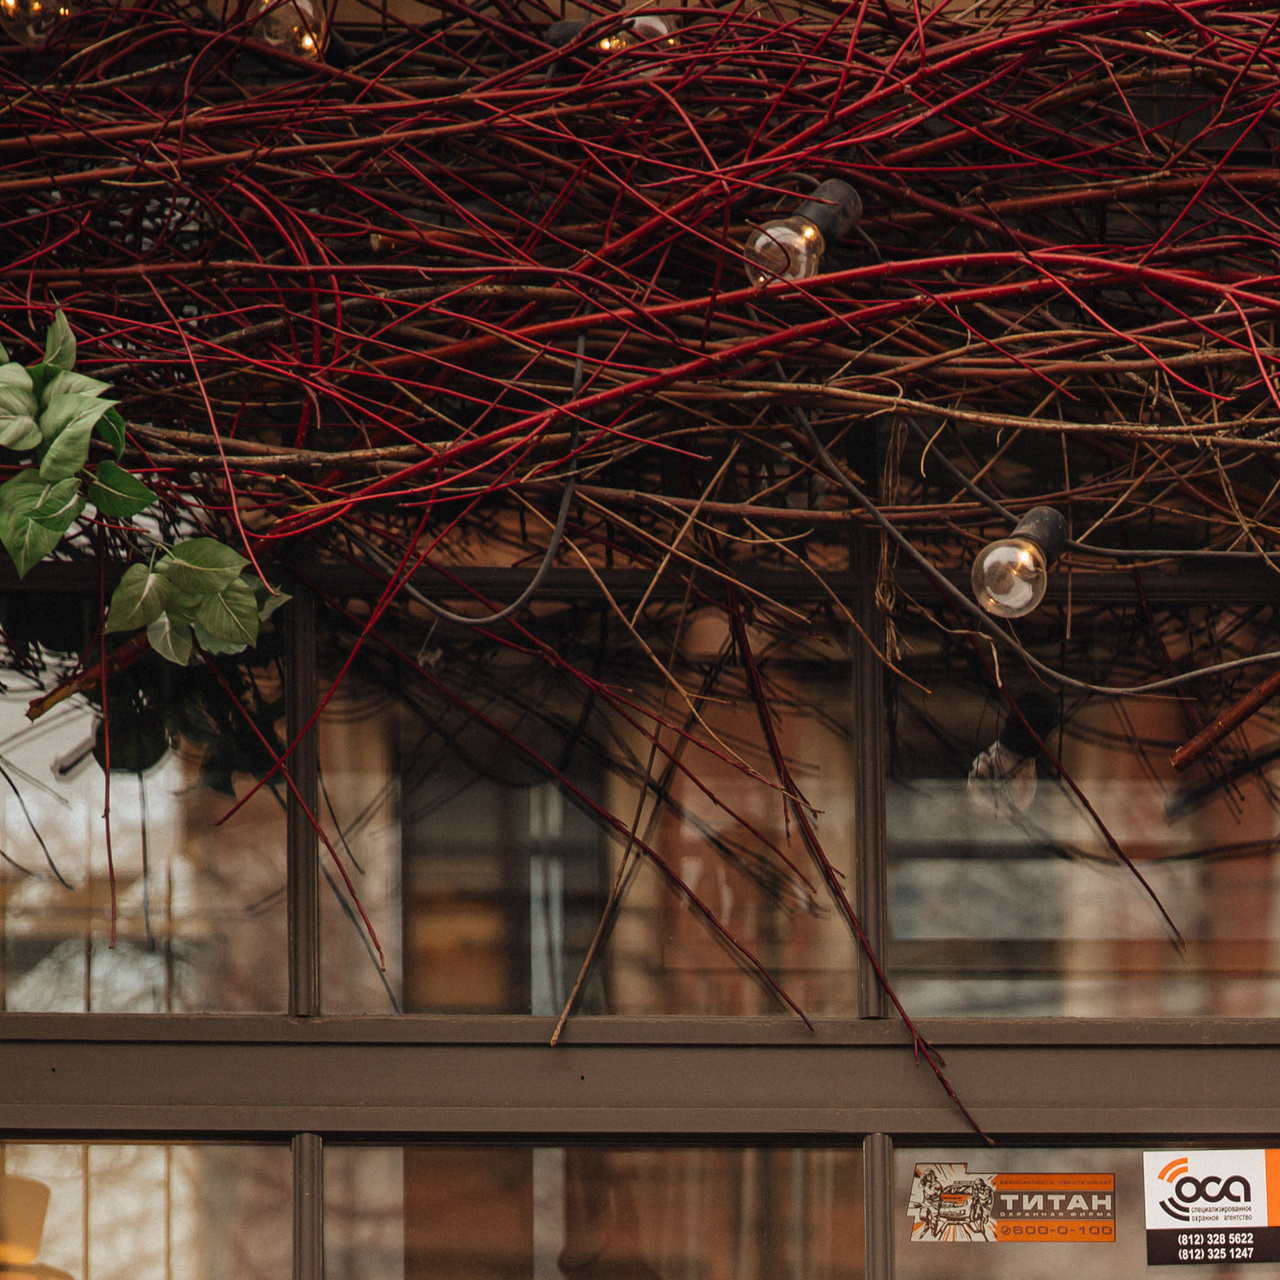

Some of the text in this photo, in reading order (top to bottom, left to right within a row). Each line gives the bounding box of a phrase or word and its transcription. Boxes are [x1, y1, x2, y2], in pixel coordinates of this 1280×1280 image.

[1000, 1194, 1111, 1210] ТИТАН
[1178, 1232, 1253, 1245] (812) 328 5622
[1178, 1247, 1254, 1260] (812) 325 1247
